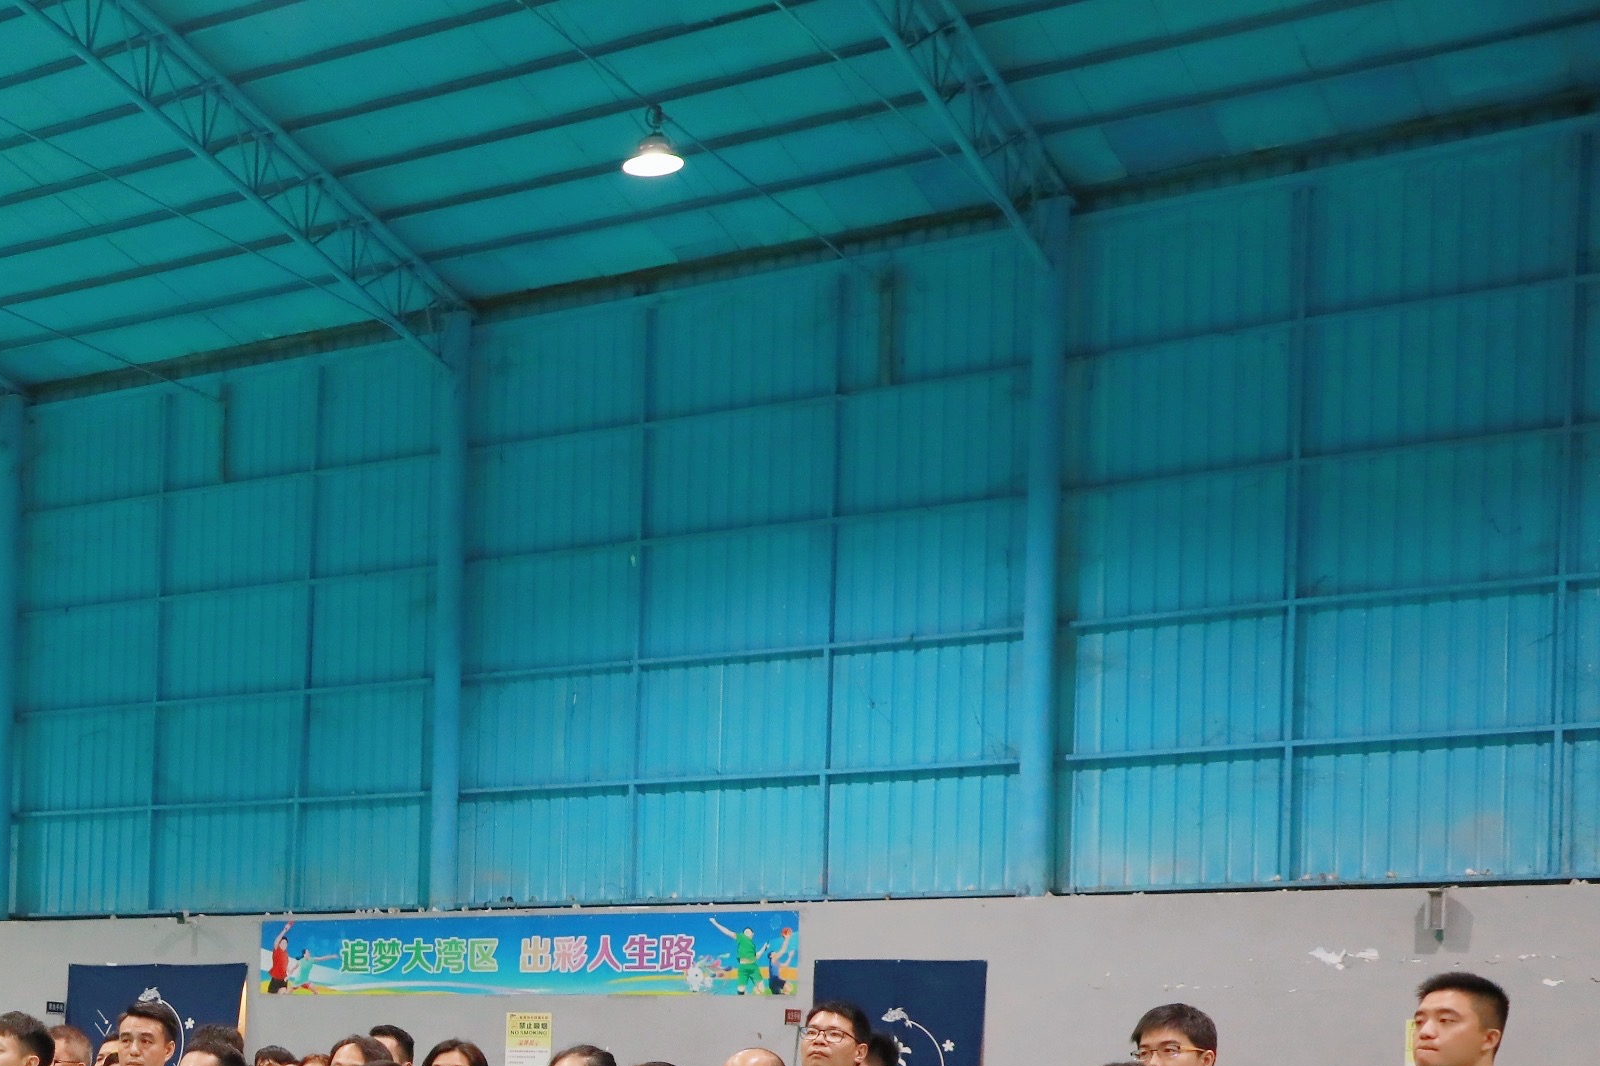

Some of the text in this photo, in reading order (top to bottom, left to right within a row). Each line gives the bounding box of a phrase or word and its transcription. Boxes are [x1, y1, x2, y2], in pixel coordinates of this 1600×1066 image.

[339, 934, 697, 975] 追梦大湾区 出彩人生路
